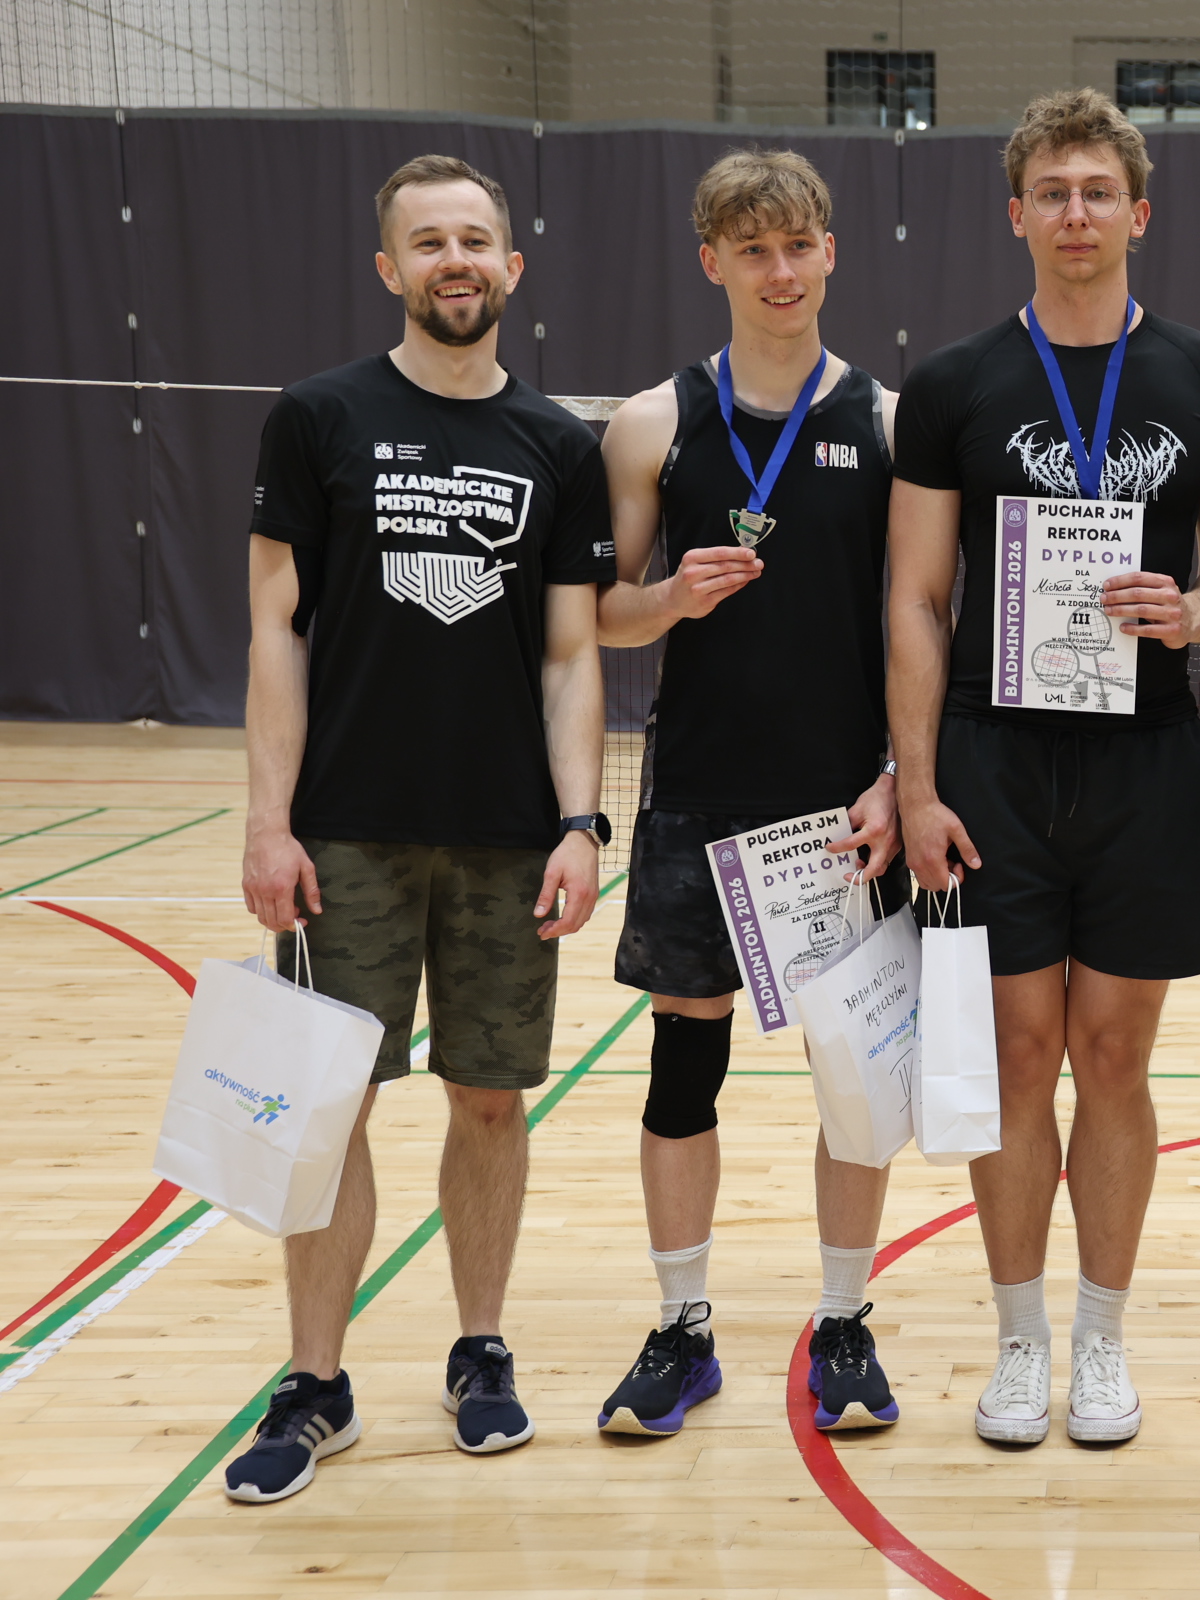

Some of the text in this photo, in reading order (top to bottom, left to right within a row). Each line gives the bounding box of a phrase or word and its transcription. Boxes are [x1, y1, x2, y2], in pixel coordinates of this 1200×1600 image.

[829, 443, 859, 469] NBA
[375, 473, 514, 503] AKADEMICKIE
[375, 494, 514, 525] MISTRZOSTWA
[1038, 504, 1104, 519] PUCHAR
[1110, 505, 1133, 520] JM
[377, 516, 448, 537] POLSKI
[1047, 527, 1122, 542] REKTORA
[1007, 540, 1022, 583] 2026
[1042, 549, 1132, 565] DYPLOM
[1072, 613, 1090, 625] III
[1004, 587, 1021, 697] BADMINTON
[747, 814, 839, 848] PUCHAR JM
[762, 837, 833, 865] REKTORA
[763, 853, 850, 887] DYPLOM
[800, 881, 815, 890] DLA
[802, 904, 840, 920] ZDOBYCIE
[813, 921, 826, 933] II
[729, 878, 780, 1023] BADMINTON 2026
[843, 954, 905, 1014] BADMINTON
[868, 1016, 911, 1060] aktywność
[205, 1068, 261, 1104] aktywność
[235, 1098, 256, 1115] na plus
